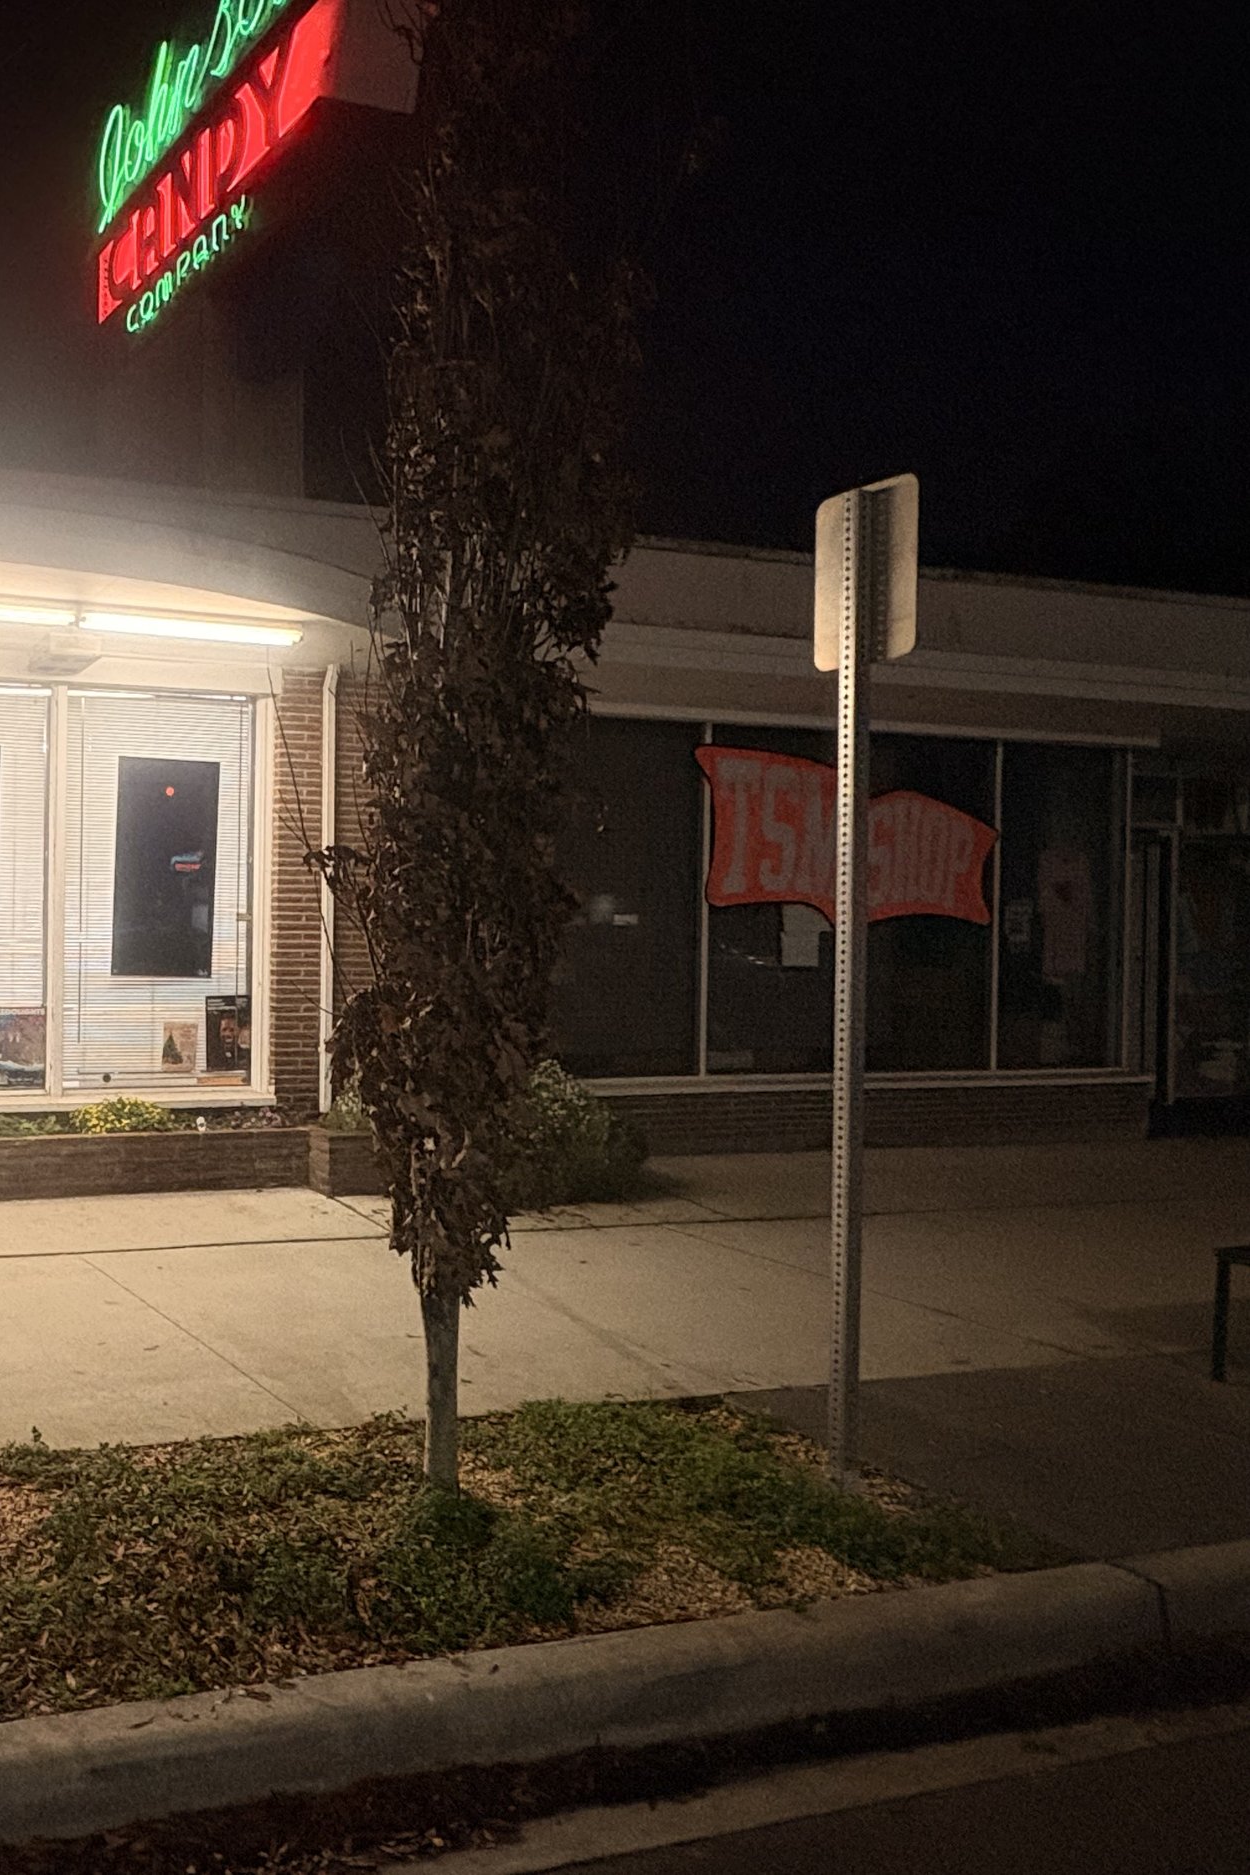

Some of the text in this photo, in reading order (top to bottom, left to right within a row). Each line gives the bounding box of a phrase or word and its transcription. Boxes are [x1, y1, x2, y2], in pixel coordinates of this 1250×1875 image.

[99, 0, 287, 233] Johns
[100, 6, 310, 312] CANDY
[126, 194, 248, 332] COMPANY
